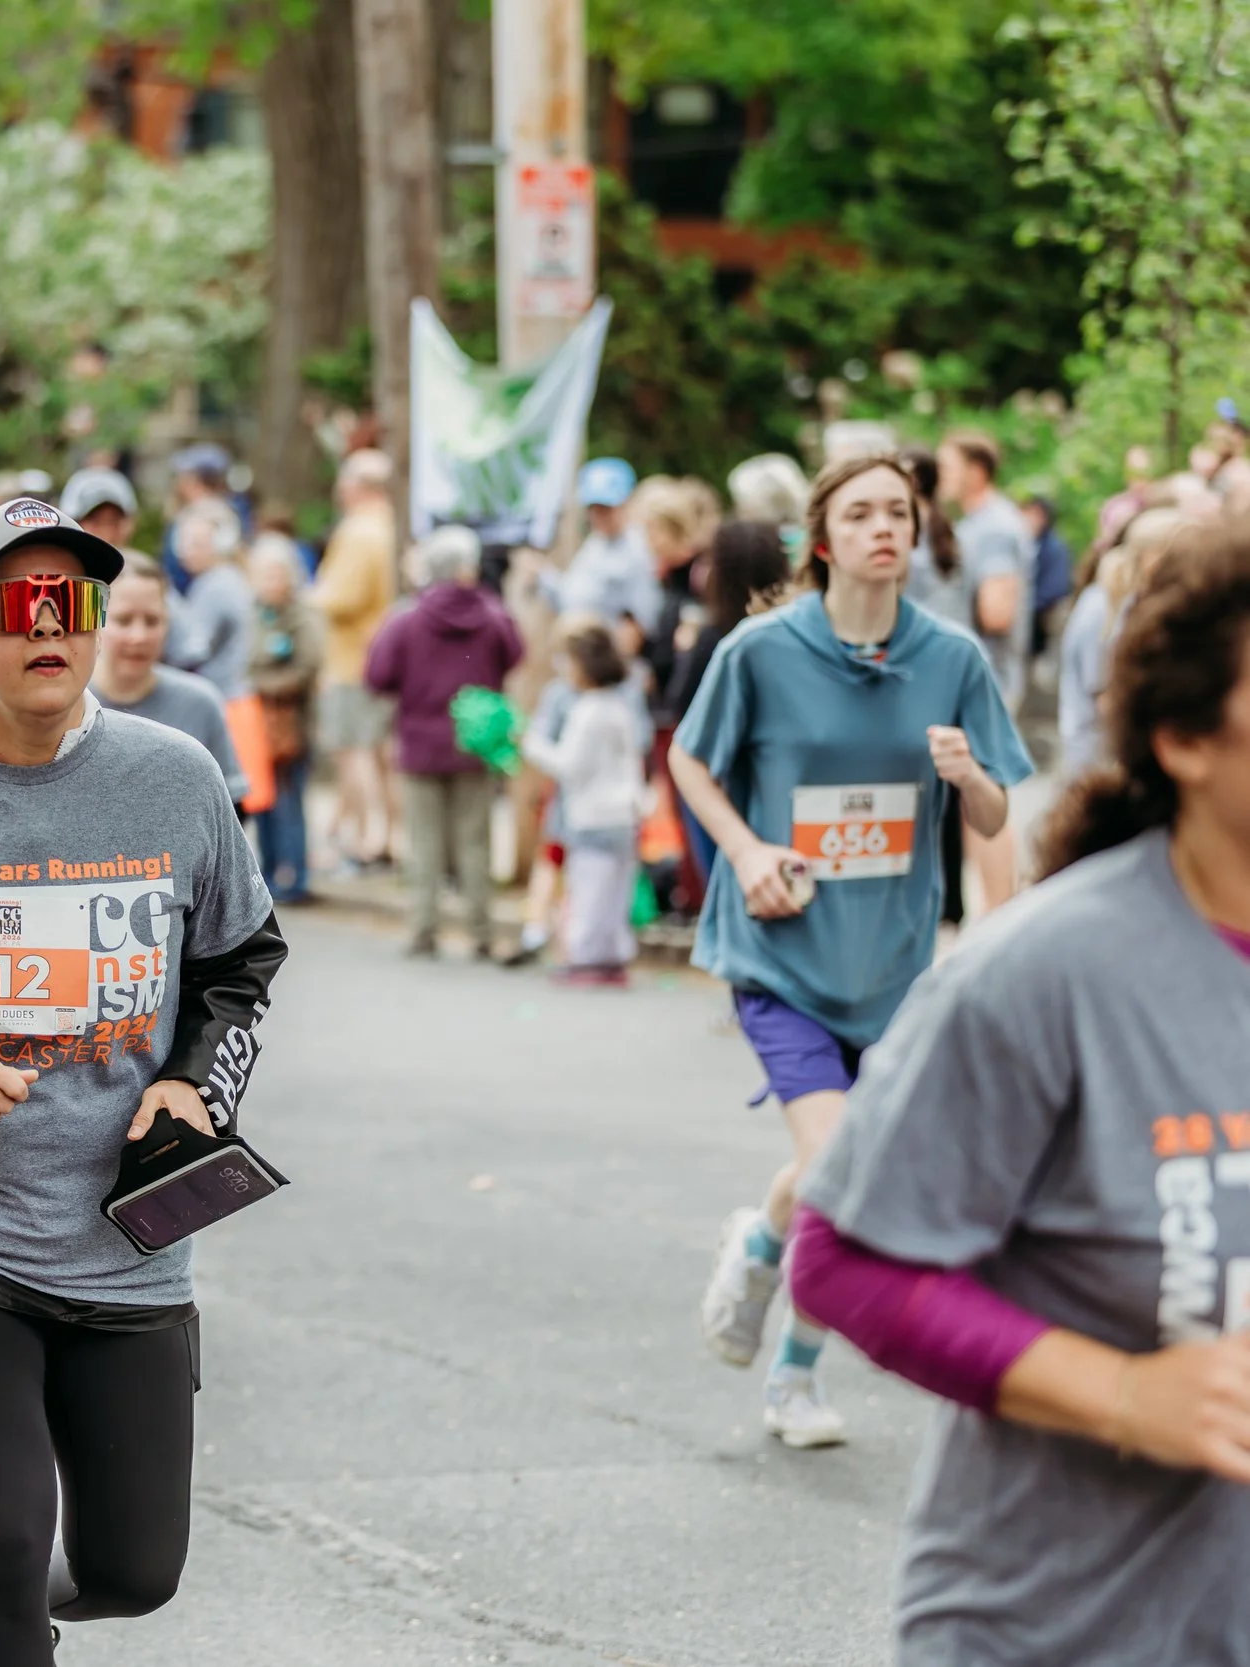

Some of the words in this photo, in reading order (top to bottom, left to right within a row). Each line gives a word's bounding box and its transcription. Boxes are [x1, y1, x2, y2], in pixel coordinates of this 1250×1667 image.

[819, 823, 889, 857] 656
[48, 852, 172, 880] Running!
[121, 1036, 153, 1057] PA
[218, 1167, 249, 1193] 9:40
